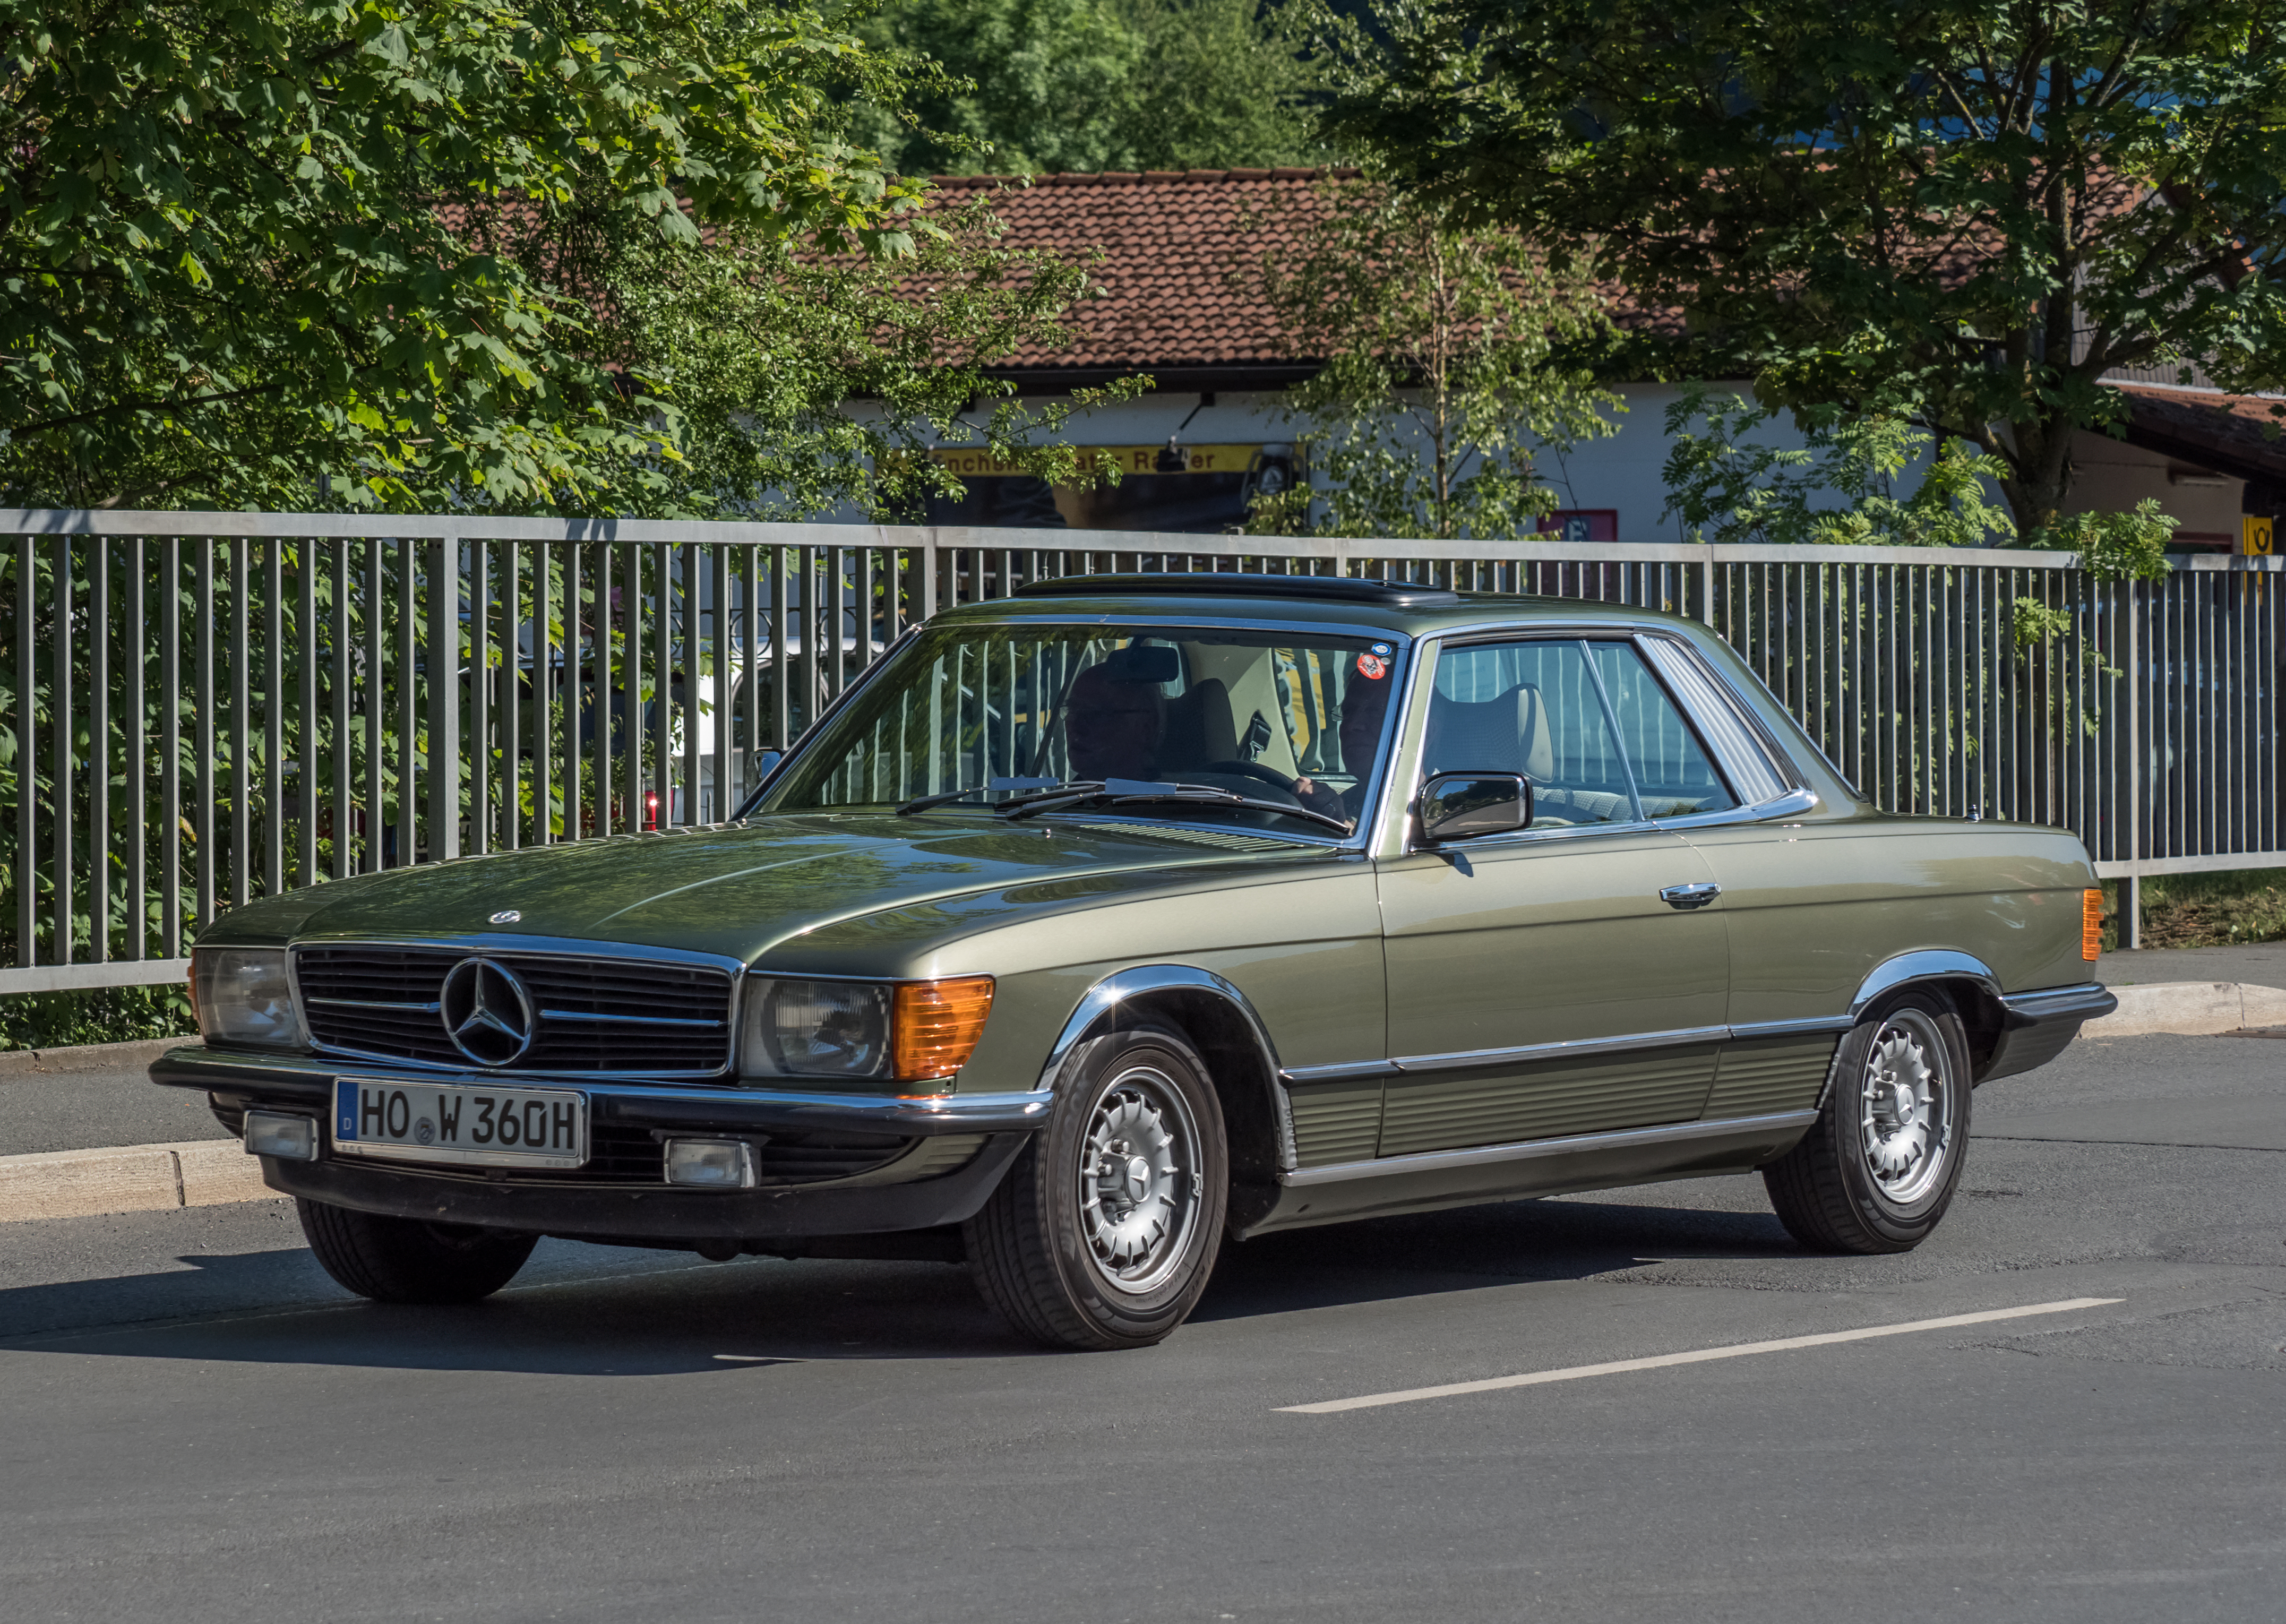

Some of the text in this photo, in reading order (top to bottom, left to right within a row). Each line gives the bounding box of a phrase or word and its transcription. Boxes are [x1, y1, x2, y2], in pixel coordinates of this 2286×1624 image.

[343, 1117, 352, 1131] D
[362, 1089, 575, 1149] HO W 360H
